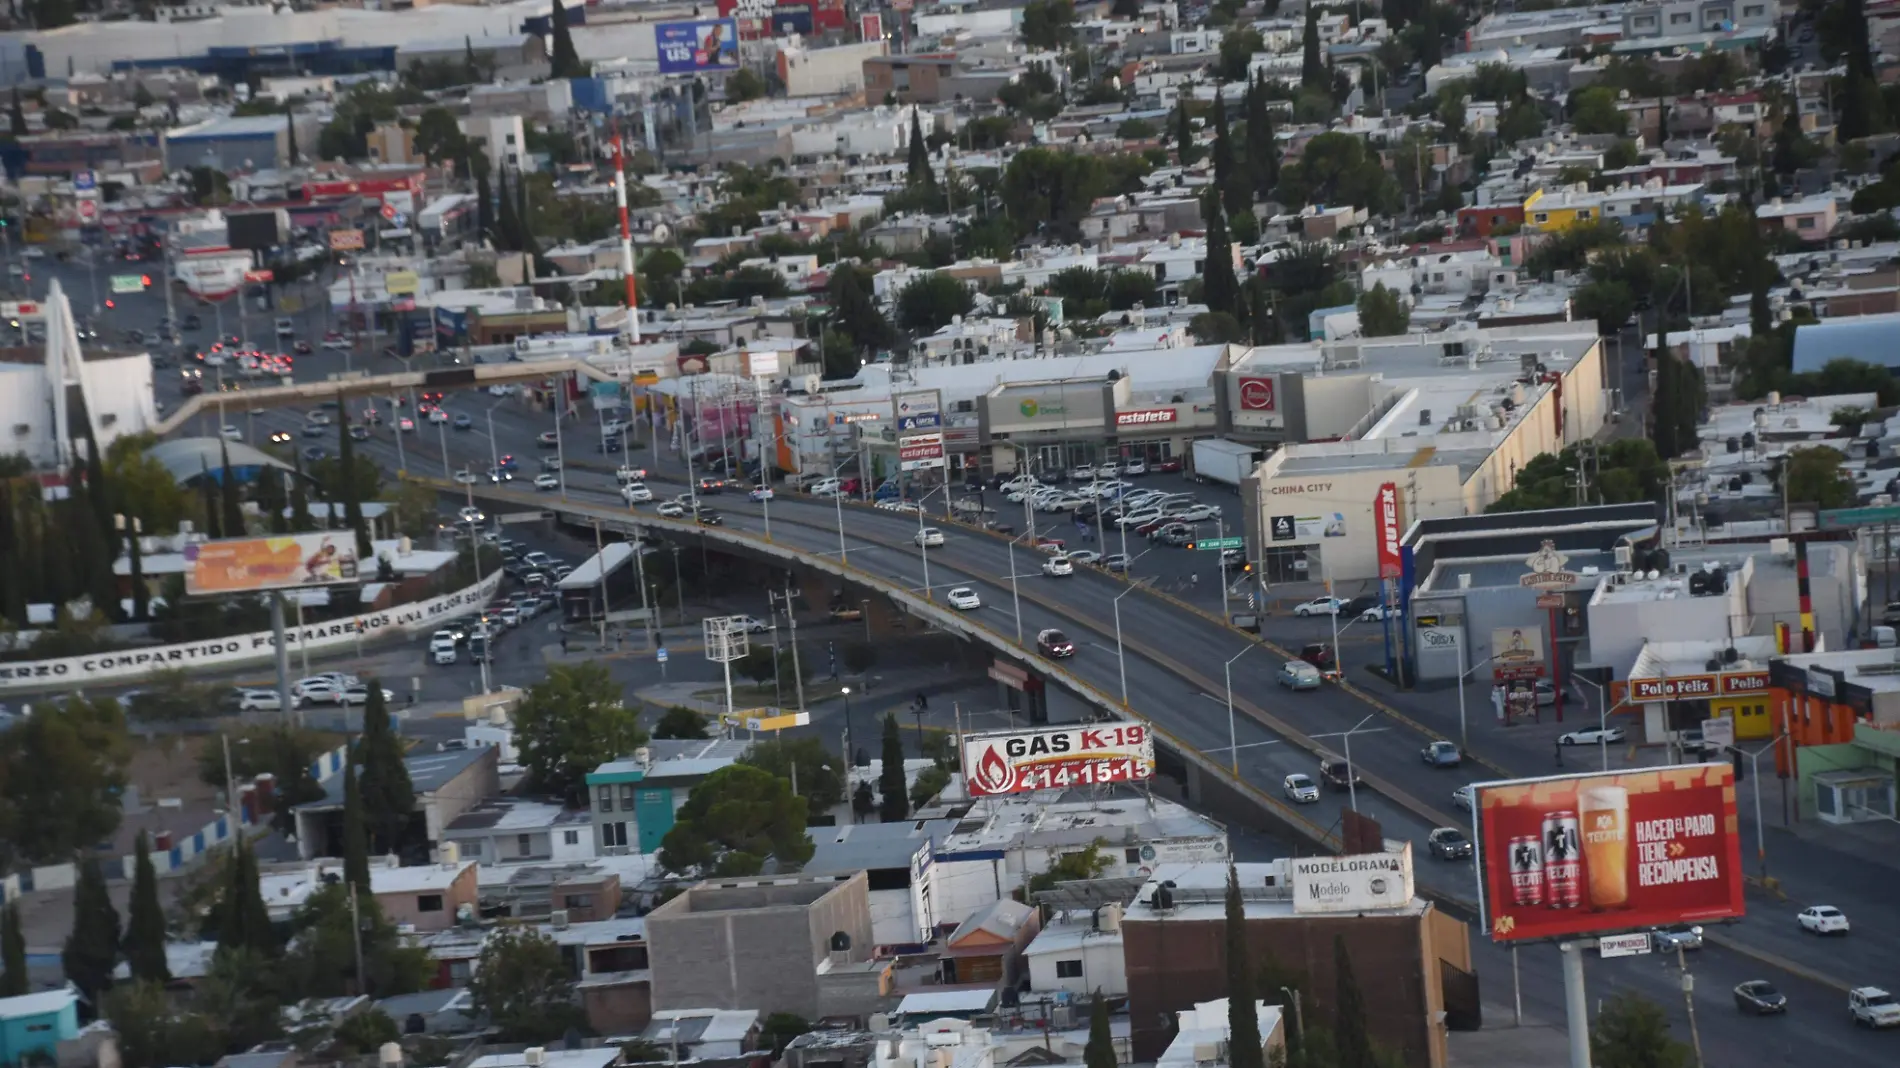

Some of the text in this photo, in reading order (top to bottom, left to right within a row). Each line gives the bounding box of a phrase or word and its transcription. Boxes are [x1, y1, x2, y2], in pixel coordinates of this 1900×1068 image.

[1118, 410, 1174, 424] estafeta
[901, 447, 939, 458] estafeta
[1271, 483, 1333, 495] CHINA CITY
[1382, 488, 1399, 557] AUTEX
[84, 642, 240, 672] COMPARTIDO
[397, 608, 422, 626] UNA
[1677, 680, 1709, 693] Feliz
[1006, 726, 1144, 757] GAS K-19
[1636, 814, 1715, 842] HACER EL PARO
[1637, 841, 1668, 862] TIENE
[1298, 859, 1399, 874] MODELORAMA
[1639, 855, 1719, 886] RECOMPENSA
[1309, 882, 1350, 899] Modelo
